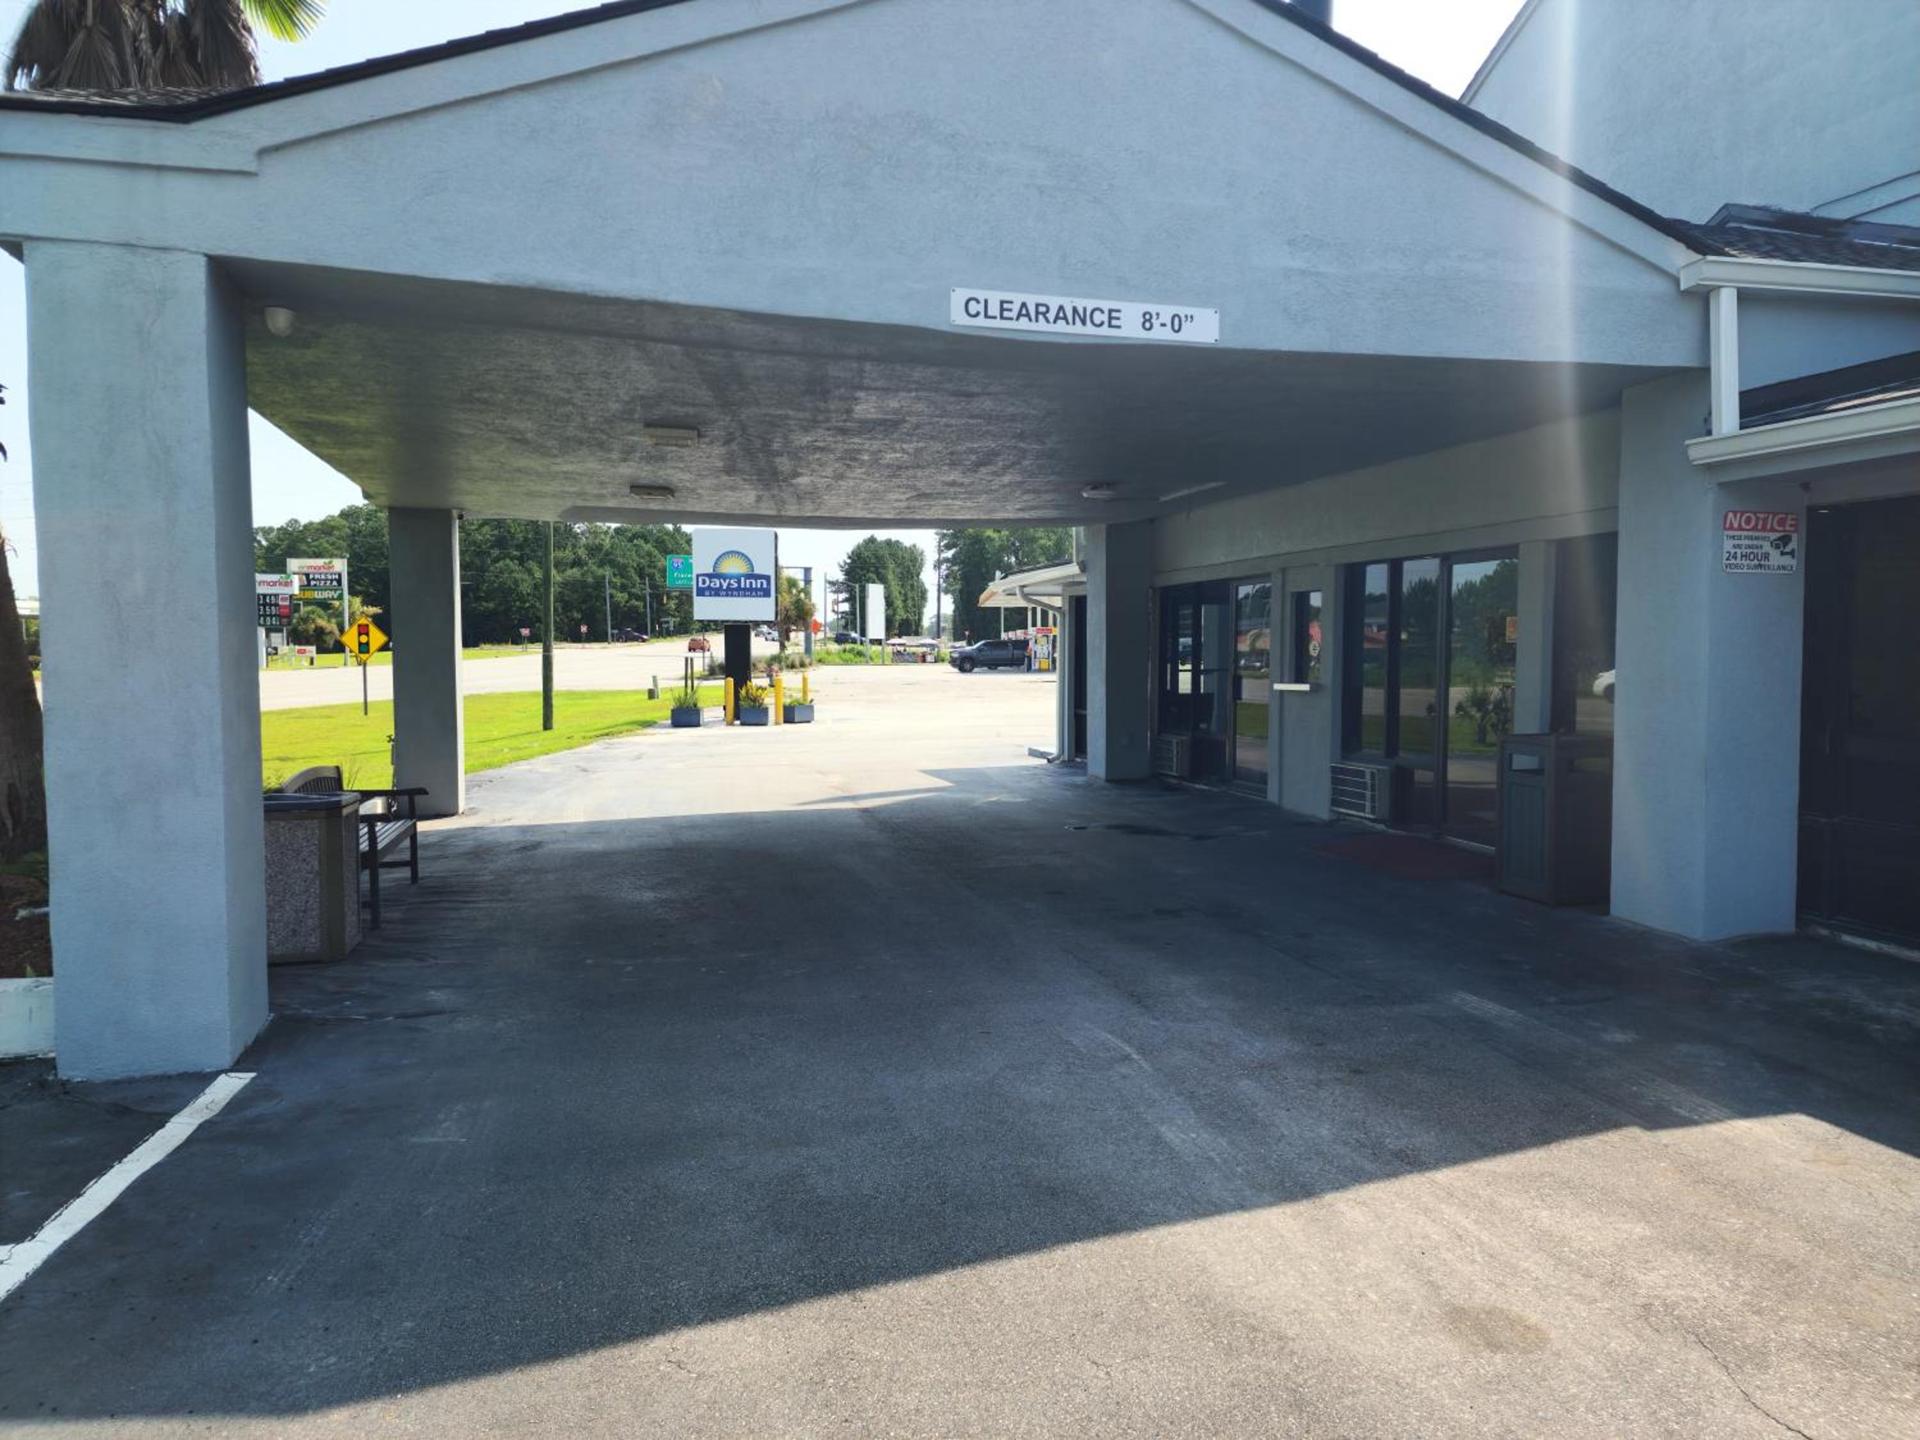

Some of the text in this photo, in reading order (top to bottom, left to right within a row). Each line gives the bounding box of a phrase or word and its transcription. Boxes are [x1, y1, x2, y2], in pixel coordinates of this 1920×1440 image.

[964, 297, 1122, 329] CLEARANCE
[1725, 511, 1797, 531] NOTICE
[1725, 550, 1770, 563] 24 HOUR
[1724, 562, 1794, 572] VIDEO SURVEILLANCE
[698, 576, 767, 590] Days Inn
